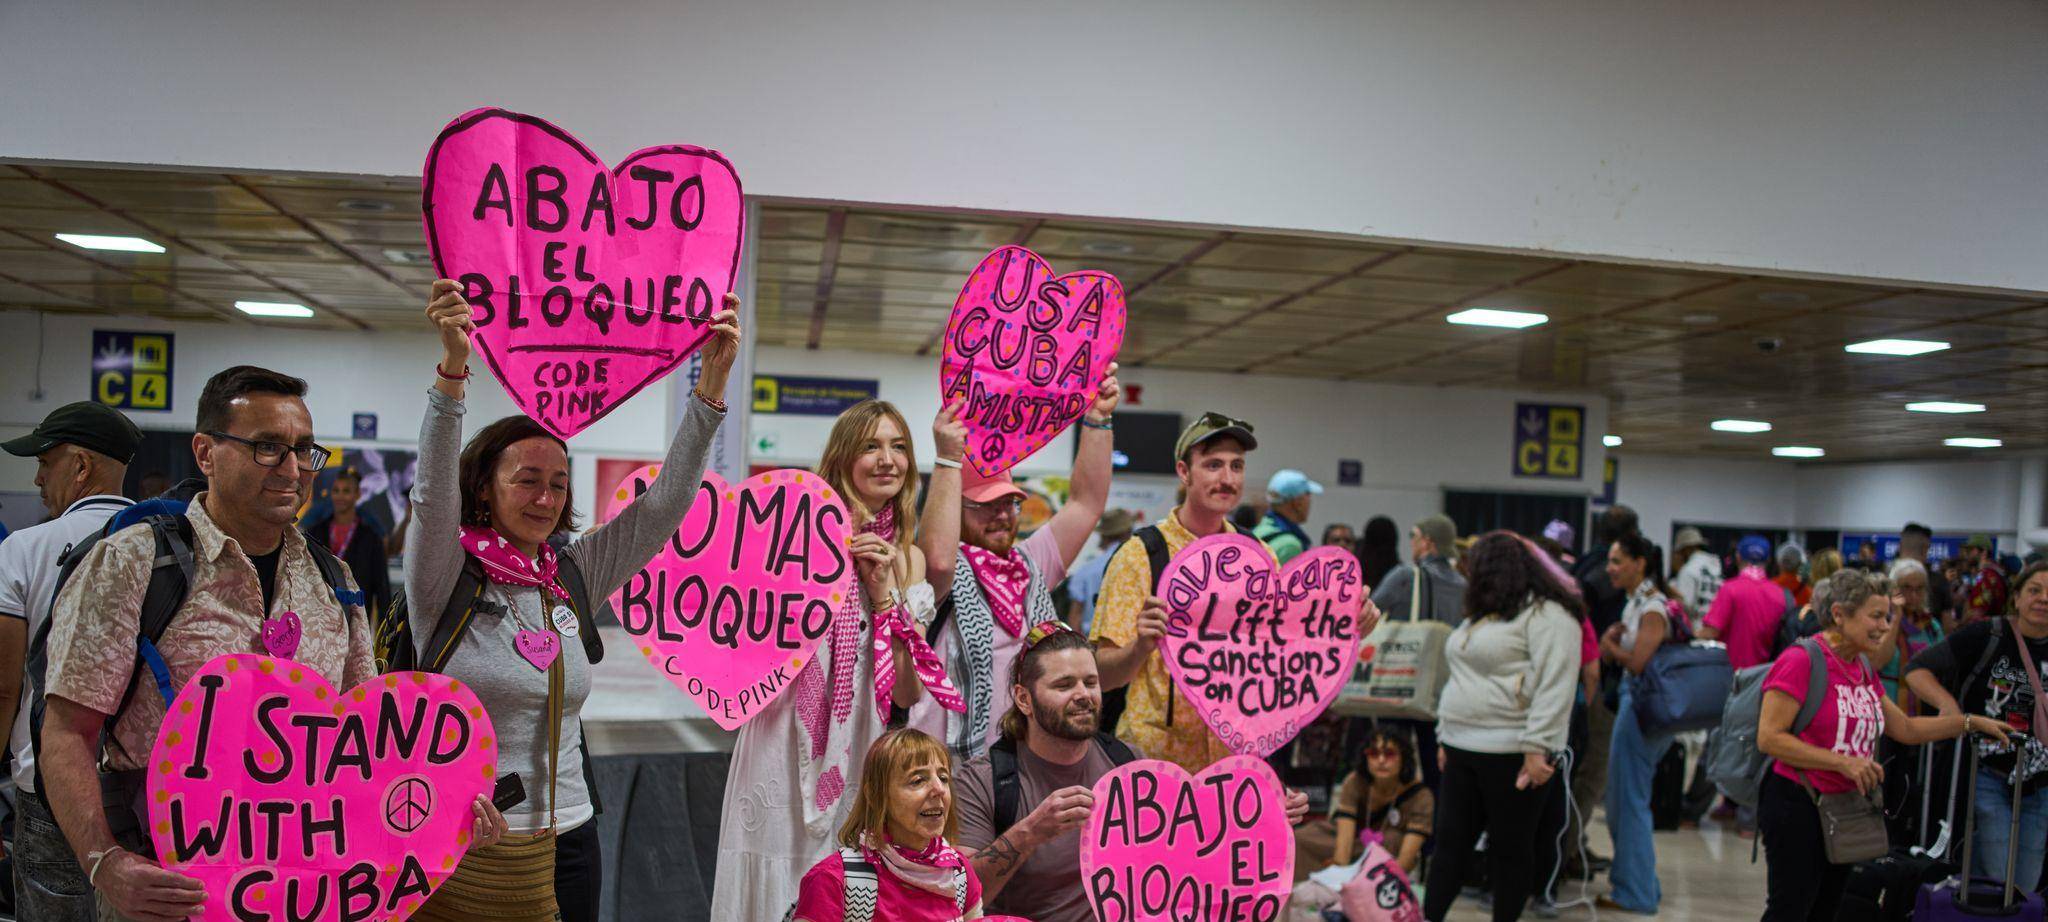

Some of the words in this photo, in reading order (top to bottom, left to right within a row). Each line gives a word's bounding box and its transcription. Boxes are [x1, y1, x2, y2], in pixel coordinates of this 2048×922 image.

[472, 162, 705, 236] ABAJO
[543, 241, 595, 282] EL
[458, 273, 713, 336] BLOQUEO
[993, 250, 1104, 339] USA
[533, 358, 610, 388] CODE
[954, 307, 1091, 388] CUBA
[99, 371, 125, 406] C
[141, 377, 157, 401] 4
[535, 390, 609, 419] PINK
[946, 357, 1087, 435] AMISTAD
[1518, 440, 1543, 474] C
[731, 486, 845, 583] MAS
[622, 569, 832, 649] BLOQUEO
[1273, 559, 1356, 612] heart
[1198, 592, 1287, 645] Lift
[1300, 599, 1353, 640] the
[1177, 640, 1341, 687] Sanctions
[1205, 682, 1232, 702] on
[1238, 673, 1319, 716] CUBA
[184, 674, 223, 779] I
[243, 691, 470, 786] STAND
[170, 796, 346, 863] WITH
[1100, 769, 1263, 858] ABAJO
[230, 855, 432, 922] CUBA
[1091, 864, 1280, 922] BLOQUEO
[1231, 840, 1279, 886] EL
